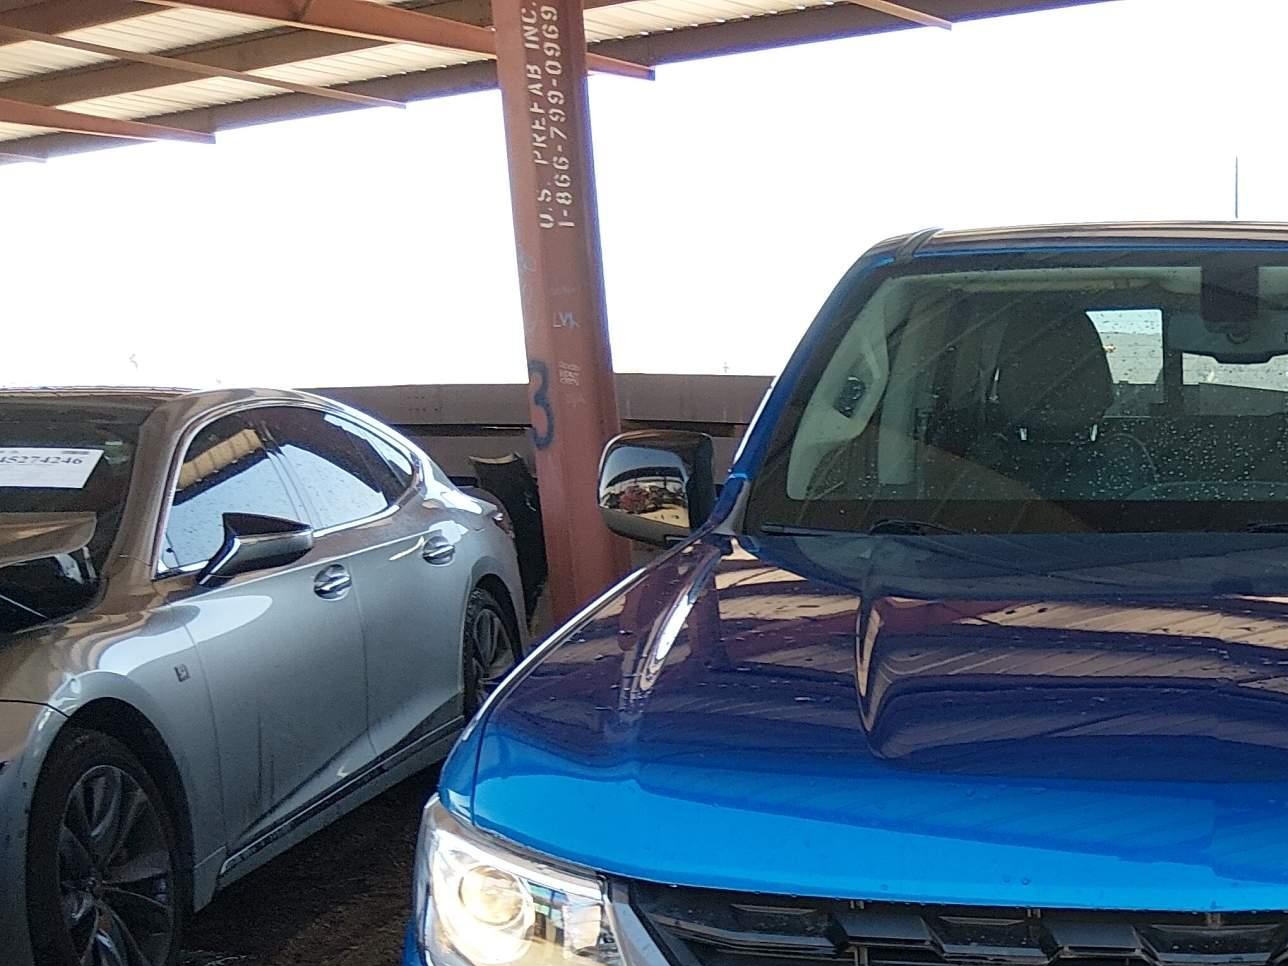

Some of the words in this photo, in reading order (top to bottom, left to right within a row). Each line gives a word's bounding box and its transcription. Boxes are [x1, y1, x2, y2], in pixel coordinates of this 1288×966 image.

[521, 1, 541, 49] INC.
[525, 64, 550, 165] PREFAB
[540, 5, 576, 227] 1-866-799-0969
[527, 359, 555, 450] 3
